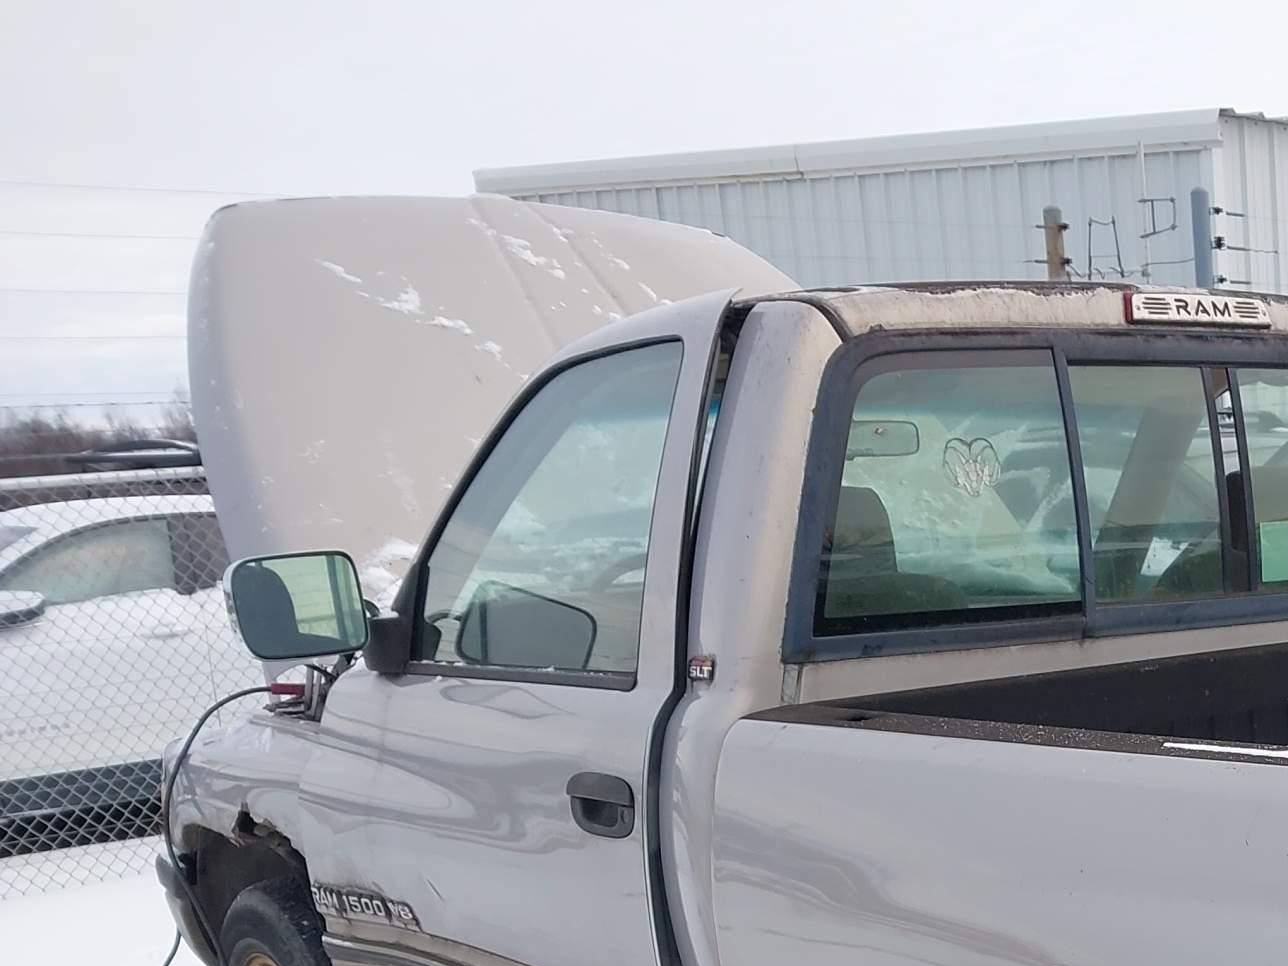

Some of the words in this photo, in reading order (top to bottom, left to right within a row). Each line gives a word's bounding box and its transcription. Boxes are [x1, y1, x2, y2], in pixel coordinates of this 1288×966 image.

[1173, 297, 1232, 318] RAM
[689, 665, 713, 678] SLT
[311, 886, 340, 910] RAM
[342, 894, 386, 917] 1500
